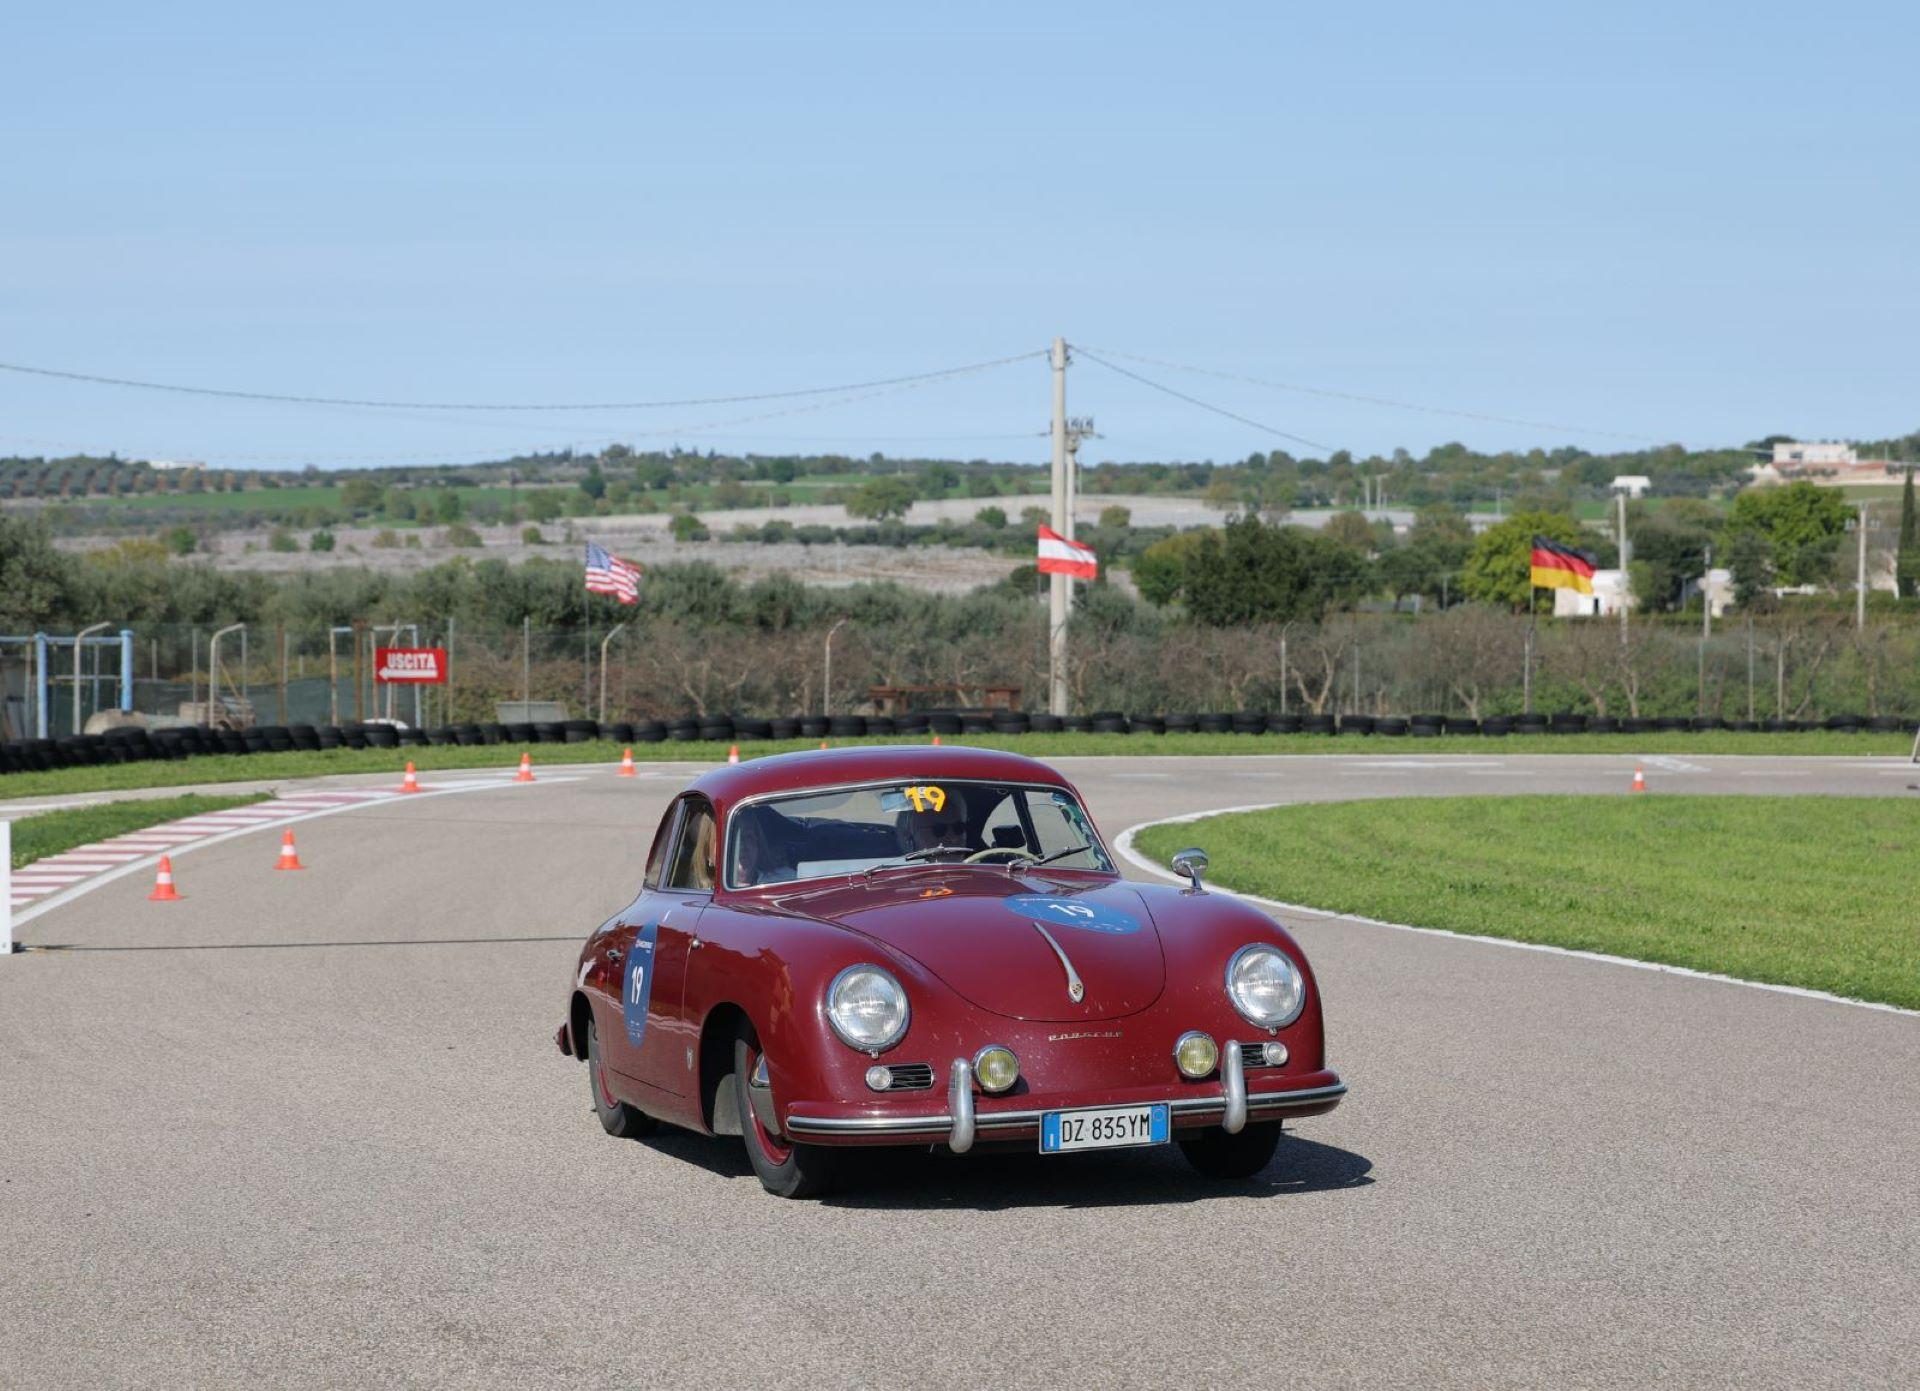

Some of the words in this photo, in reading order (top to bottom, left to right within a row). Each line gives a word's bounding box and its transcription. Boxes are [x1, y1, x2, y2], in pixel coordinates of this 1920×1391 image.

[386, 652, 437, 669] USCITA
[904, 785, 946, 812] 19
[1048, 904, 1095, 918] 19
[631, 965, 644, 1005] 19
[1061, 1118, 1085, 1143] DZ
[1091, 1112, 1151, 1141] 835YM
